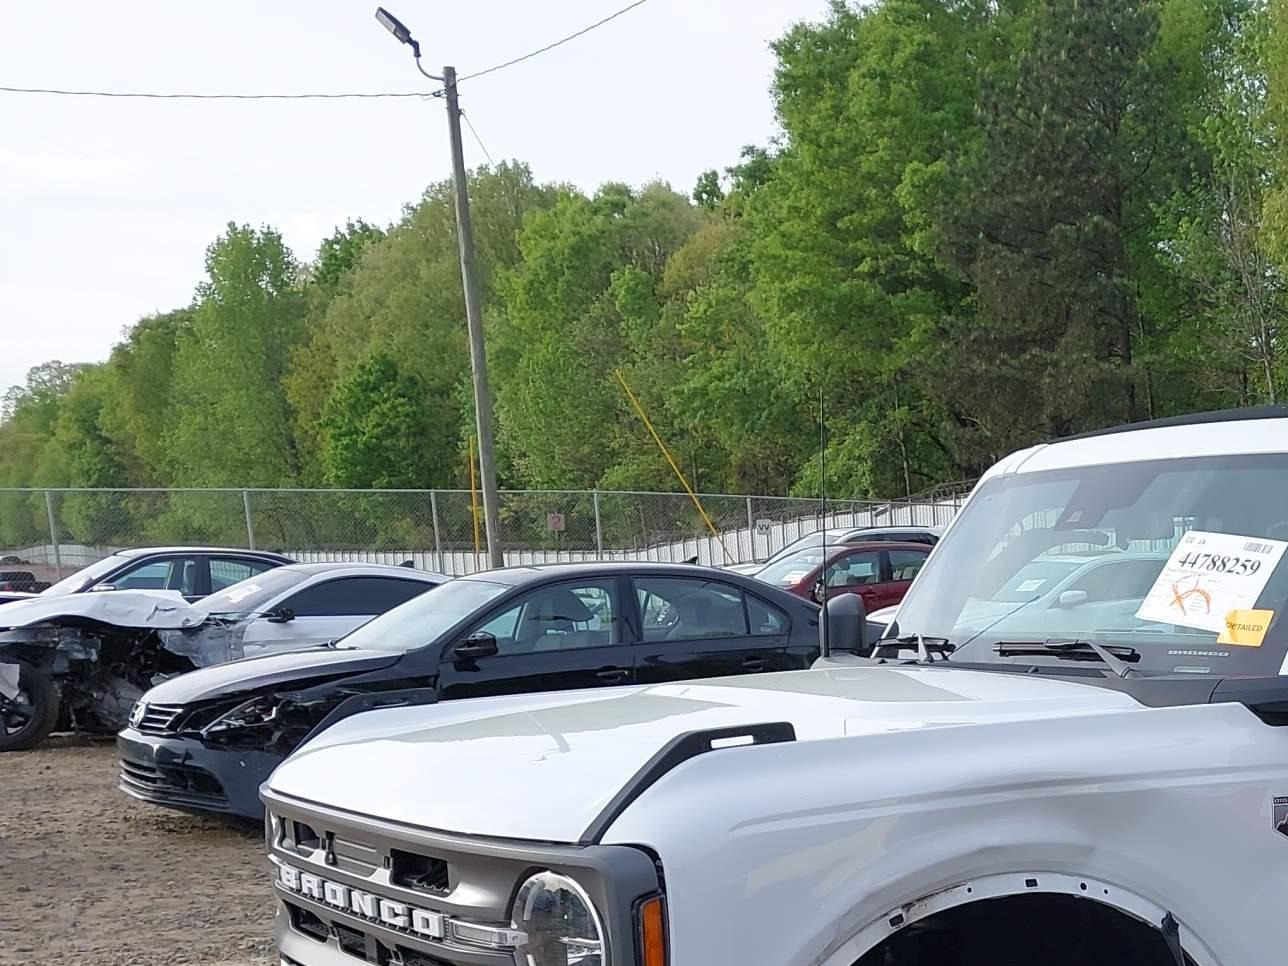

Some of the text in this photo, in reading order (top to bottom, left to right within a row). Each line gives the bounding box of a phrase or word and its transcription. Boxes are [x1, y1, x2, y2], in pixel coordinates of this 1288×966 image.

[1179, 552, 1262, 577] 44788259
[1226, 621, 1263, 632] DETAILED
[280, 862, 444, 939] BRONCO
